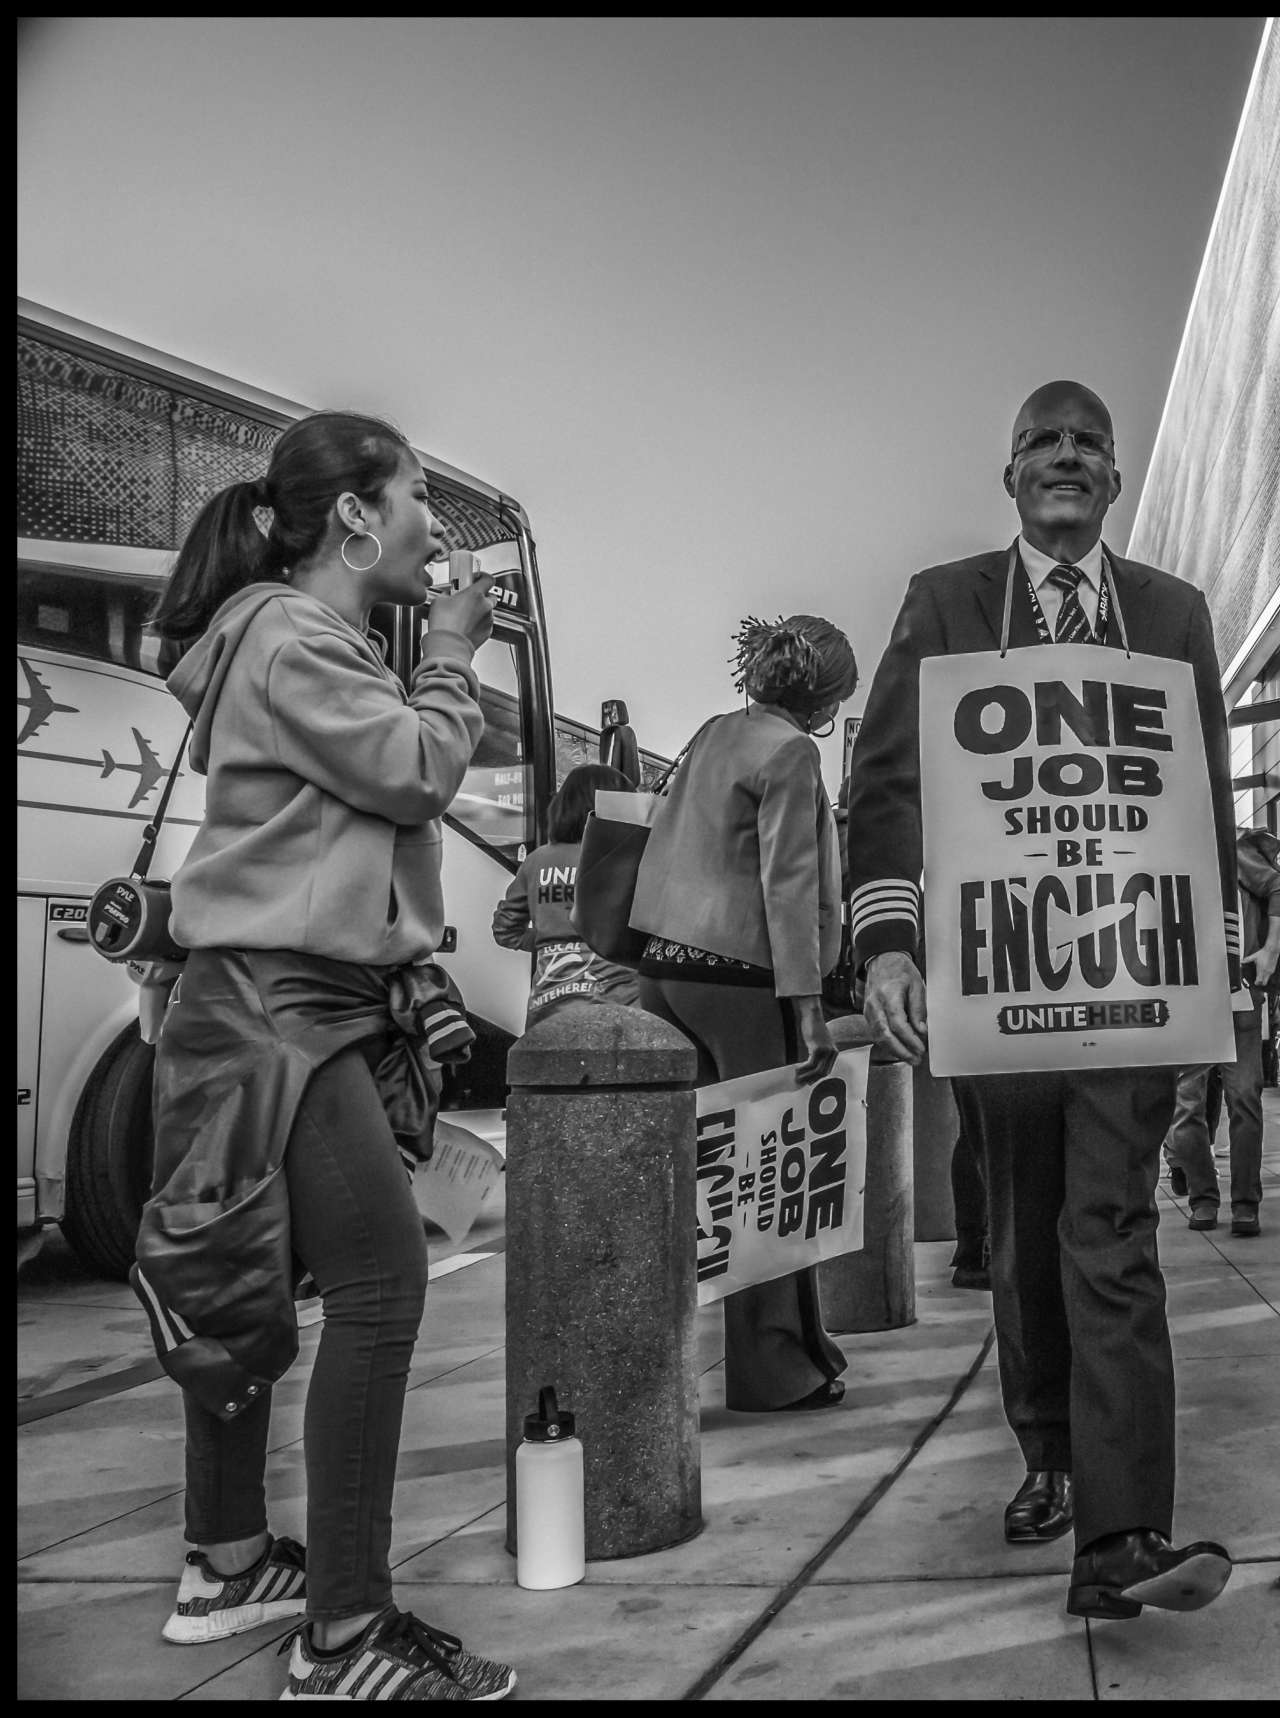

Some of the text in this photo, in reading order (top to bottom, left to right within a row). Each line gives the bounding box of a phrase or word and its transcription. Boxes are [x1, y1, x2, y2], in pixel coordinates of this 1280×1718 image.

[953, 679, 1174, 755] ONE
[981, 753, 1164, 801] JOB
[1004, 804, 1149, 836] SHOULD
[1057, 838, 1103, 868] BE
[53, 906, 89, 920] C20
[116, 886, 135, 902] PYLE
[960, 872, 1200, 997] ENOUGH
[529, 982, 593, 1006] NITEHERE!
[778, 1107, 806, 1237] JOB
[805, 1077, 847, 1240] ONE
[737, 1171, 756, 1207] BE
[757, 1130, 777, 1232] SHOULD
